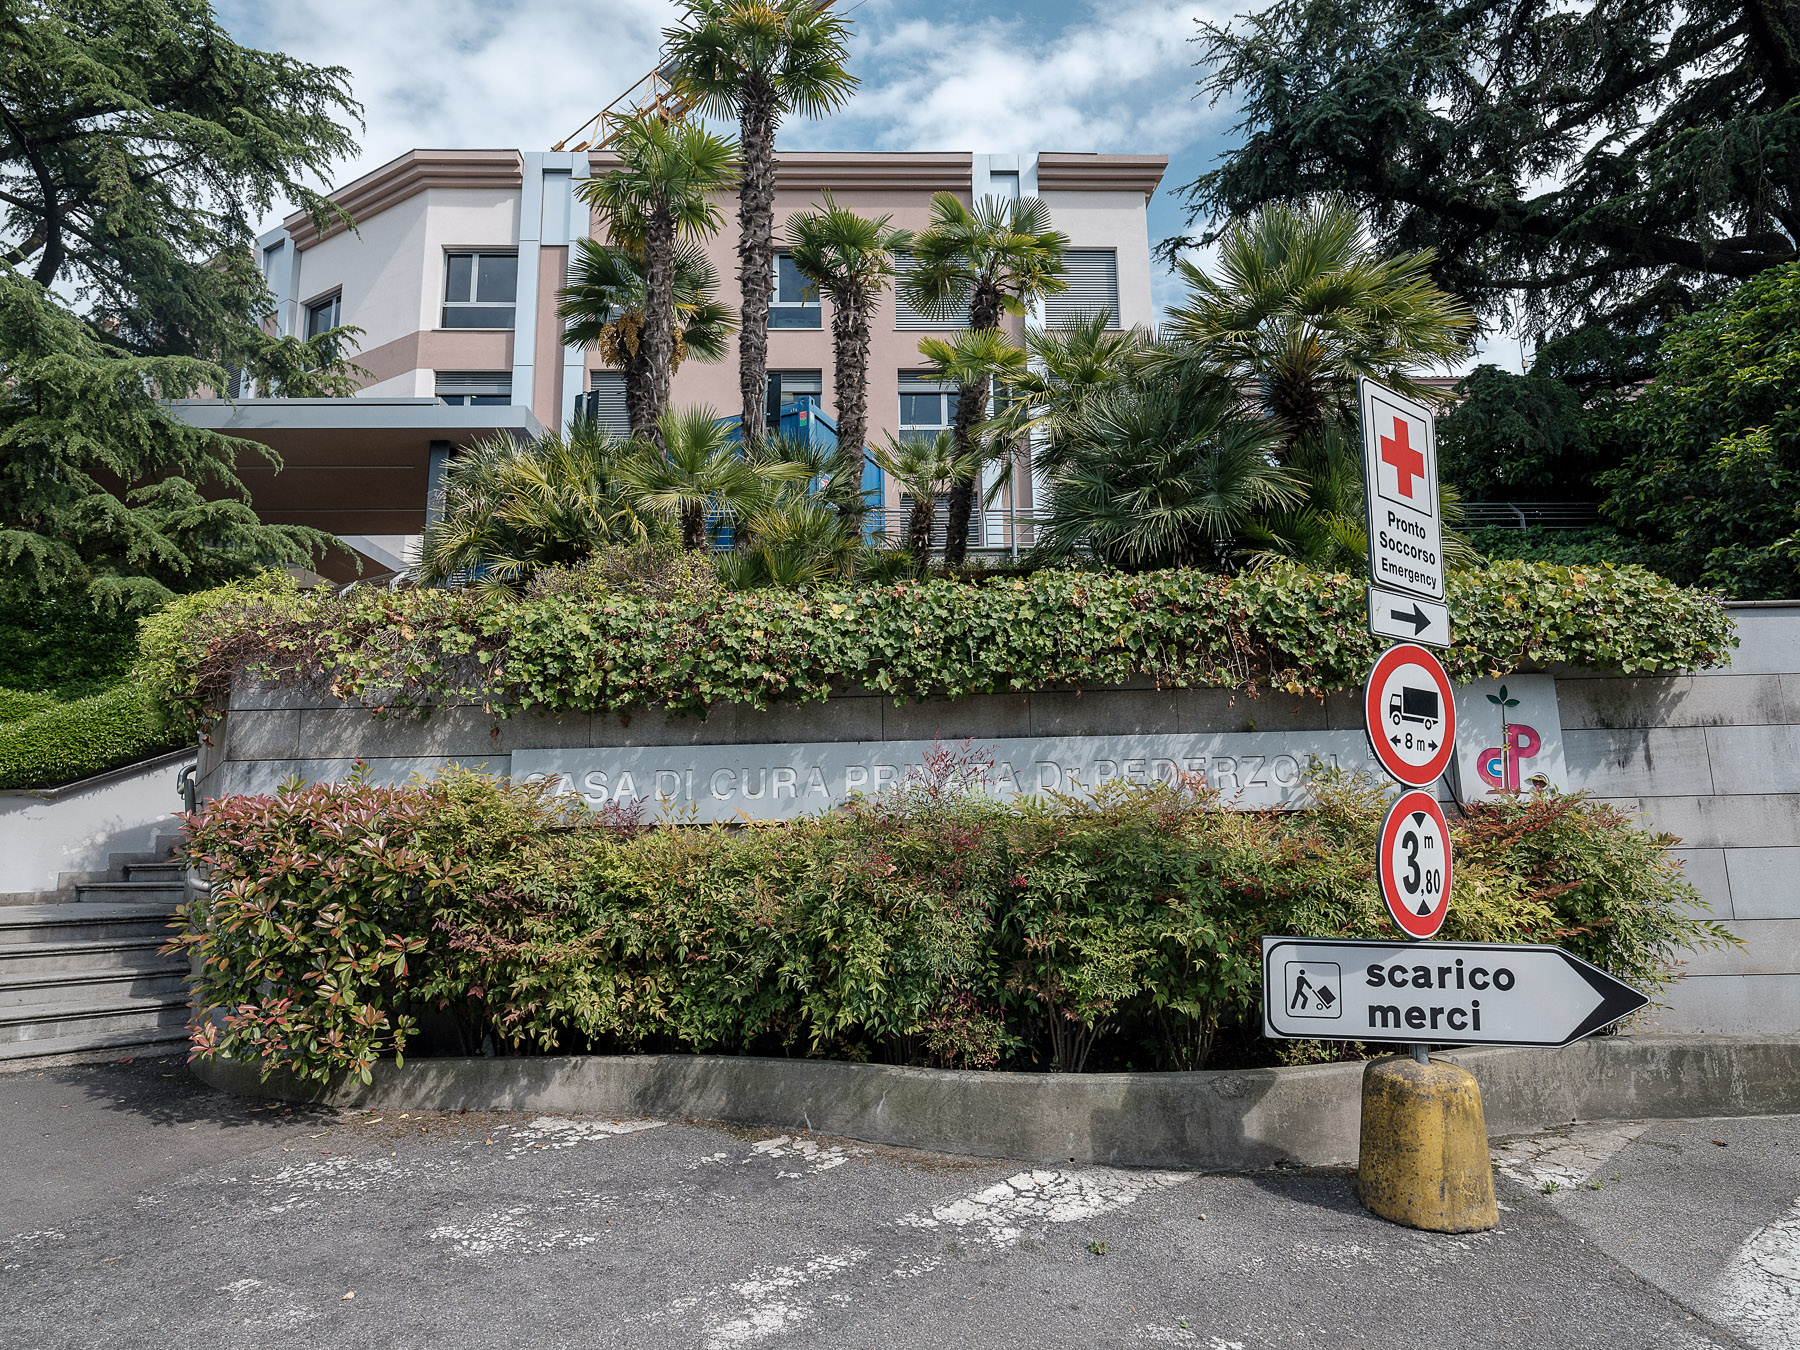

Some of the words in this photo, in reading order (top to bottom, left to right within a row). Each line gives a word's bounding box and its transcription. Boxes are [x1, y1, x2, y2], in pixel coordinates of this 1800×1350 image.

[1387, 510, 1426, 540] Pronto
[1379, 531, 1436, 565] Soccorso
[1381, 556, 1437, 590] Emergency
[1405, 732, 1413, 750] 8
[1416, 738, 1426, 752] m
[654, 768, 693, 801] DI
[708, 765, 831, 801] CURA
[1423, 835, 1434, 849] m
[1365, 958, 1516, 992] scarico
[1367, 1000, 1482, 1032] merci
